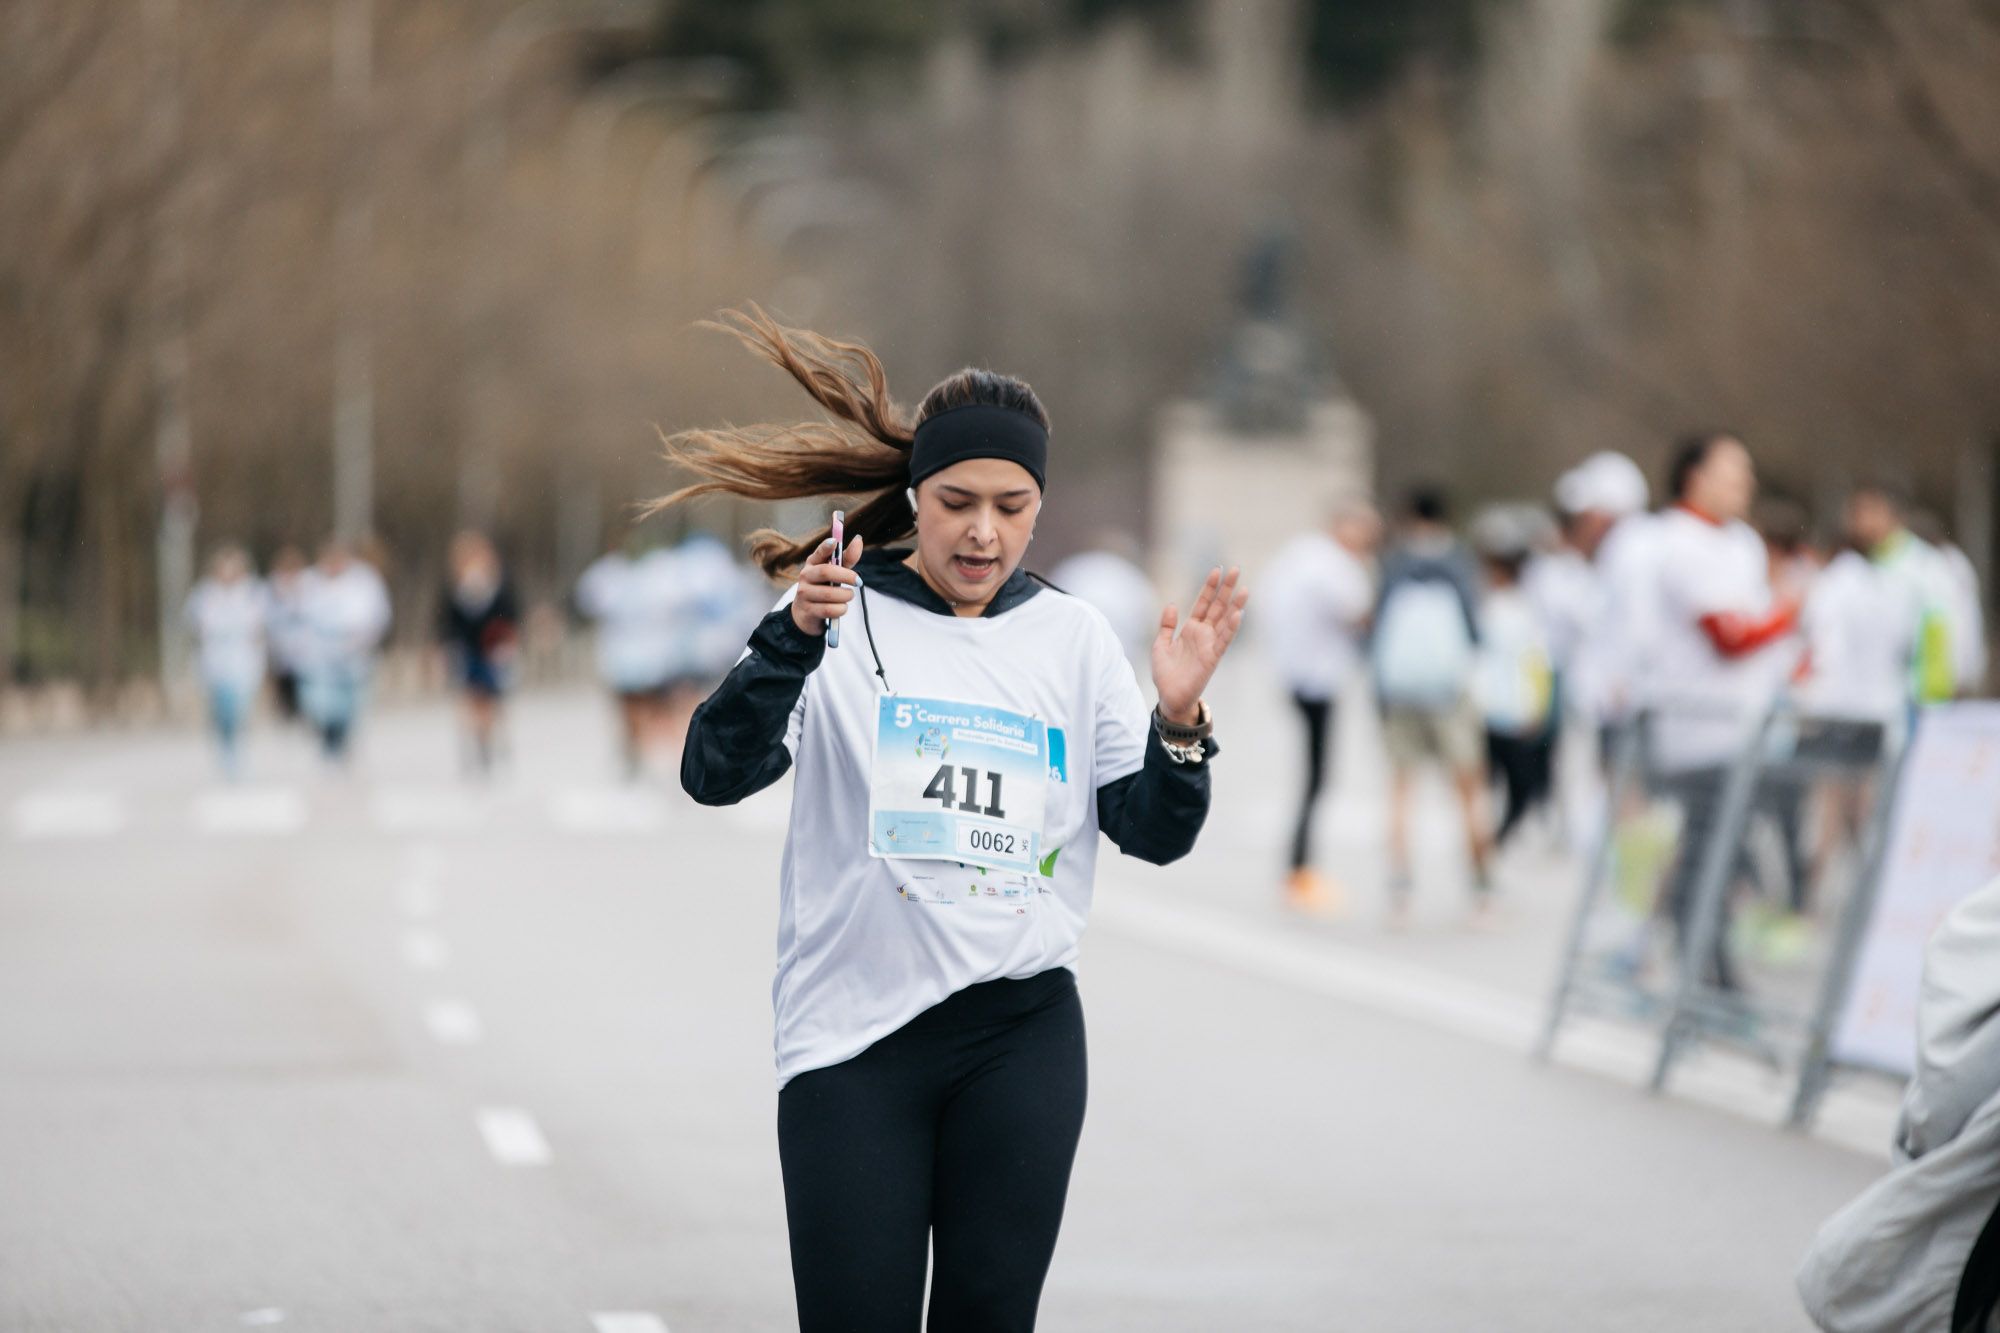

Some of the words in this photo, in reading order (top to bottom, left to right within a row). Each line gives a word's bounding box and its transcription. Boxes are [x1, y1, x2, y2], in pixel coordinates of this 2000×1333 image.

[917, 709, 970, 727] Carrera
[974, 715, 1025, 738] Solidaria
[923, 764, 1005, 819] 411
[970, 829, 1015, 854] 0062
